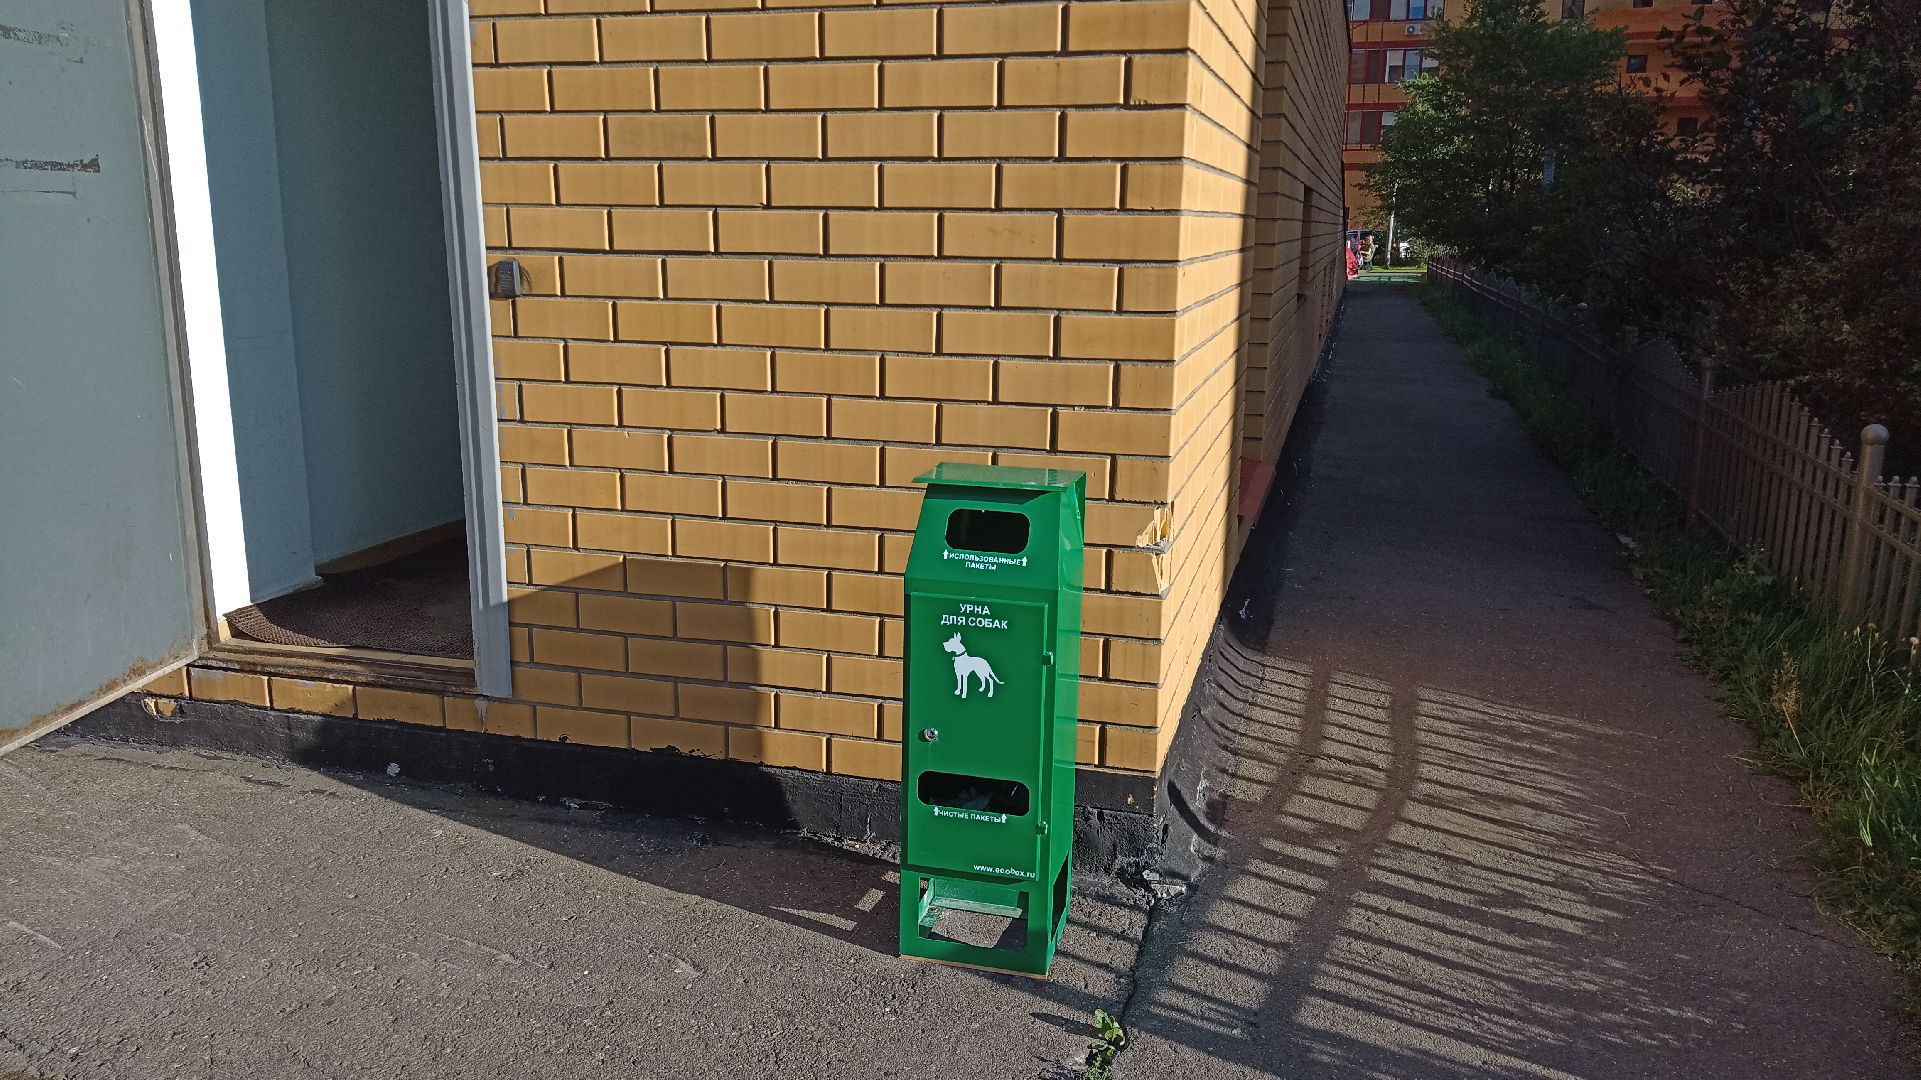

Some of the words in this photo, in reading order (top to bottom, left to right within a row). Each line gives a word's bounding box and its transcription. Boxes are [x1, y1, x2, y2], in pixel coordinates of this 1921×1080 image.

[949, 553, 1021, 565] ИСПОЛЬЗОВАННЫЕ
[965, 561, 996, 570] ПАКЕТЫ
[959, 603, 990, 615] УРНА
[940, 614, 966, 626] ДЛЯ
[968, 615, 1008, 629] СОБАК
[938, 809, 969, 820] ЧИСТЫЕ
[970, 813, 1001, 823] ПАКЕТЫ
[973, 864, 1035, 878] www.ecobox.ru
